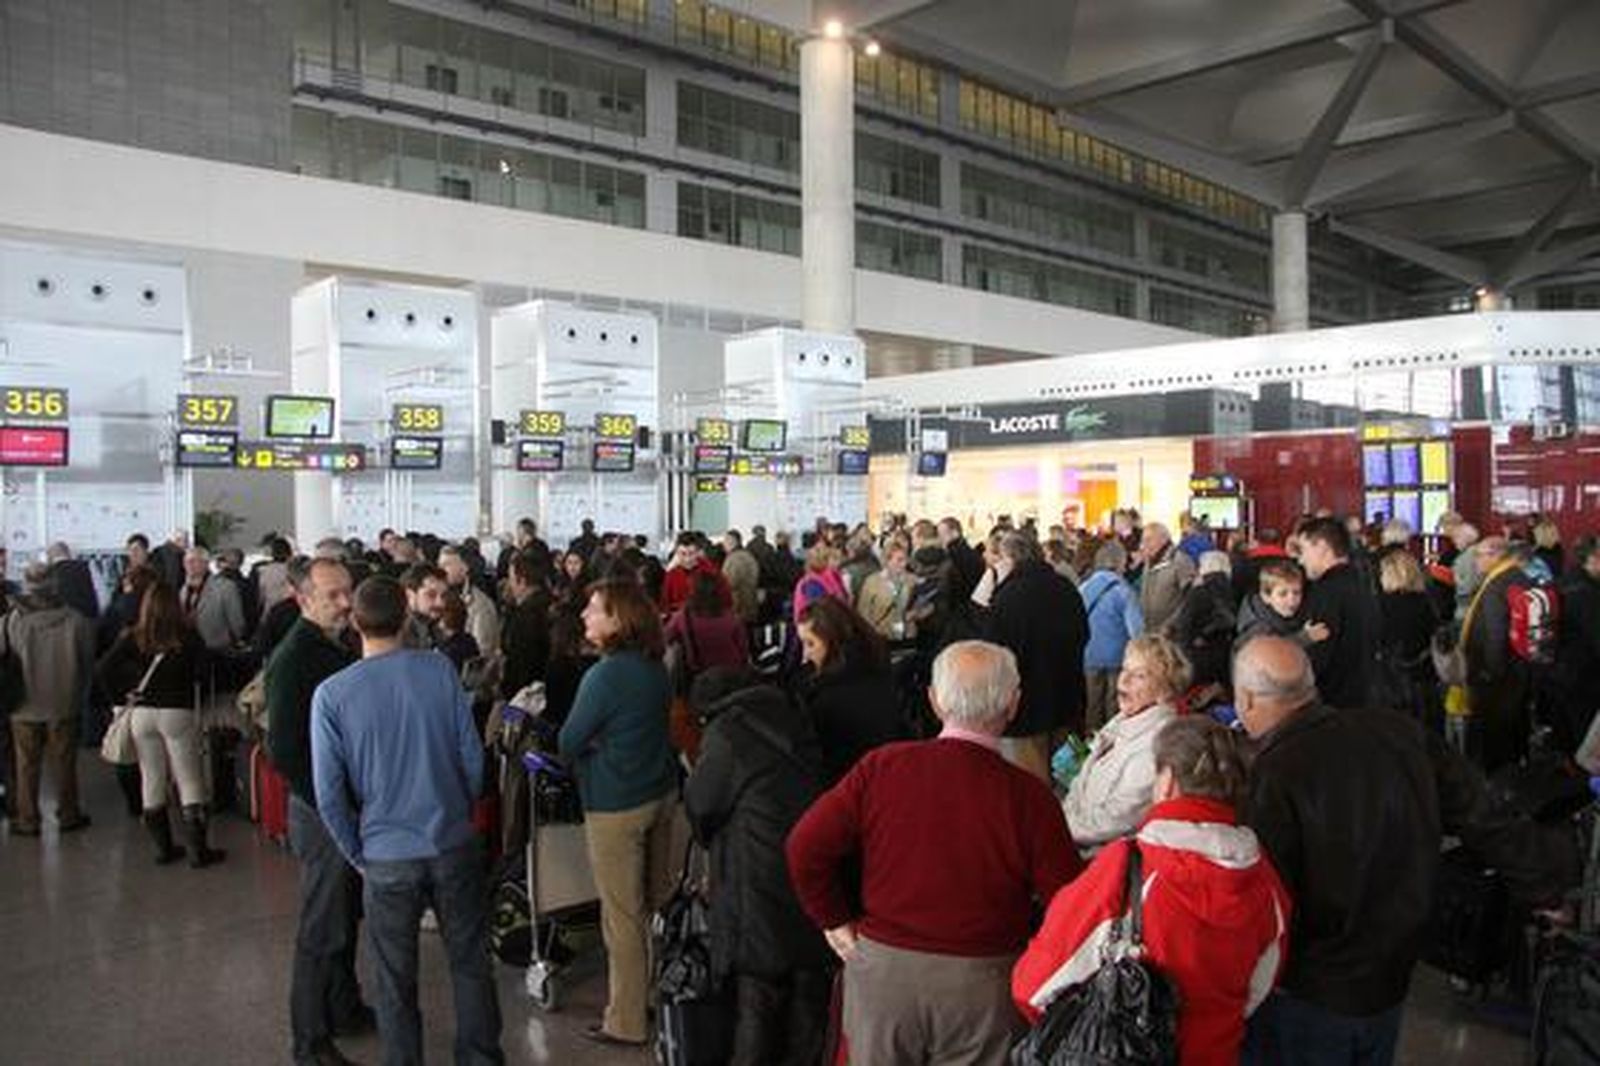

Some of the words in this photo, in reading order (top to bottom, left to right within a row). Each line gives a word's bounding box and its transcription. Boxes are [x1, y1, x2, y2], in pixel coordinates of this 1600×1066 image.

[5, 390, 63, 416] 356
[184, 398, 233, 422] 357
[399, 408, 439, 429] 358
[527, 412, 562, 434] 359
[601, 415, 633, 436] 360
[990, 413, 1060, 433] LACOSTE
